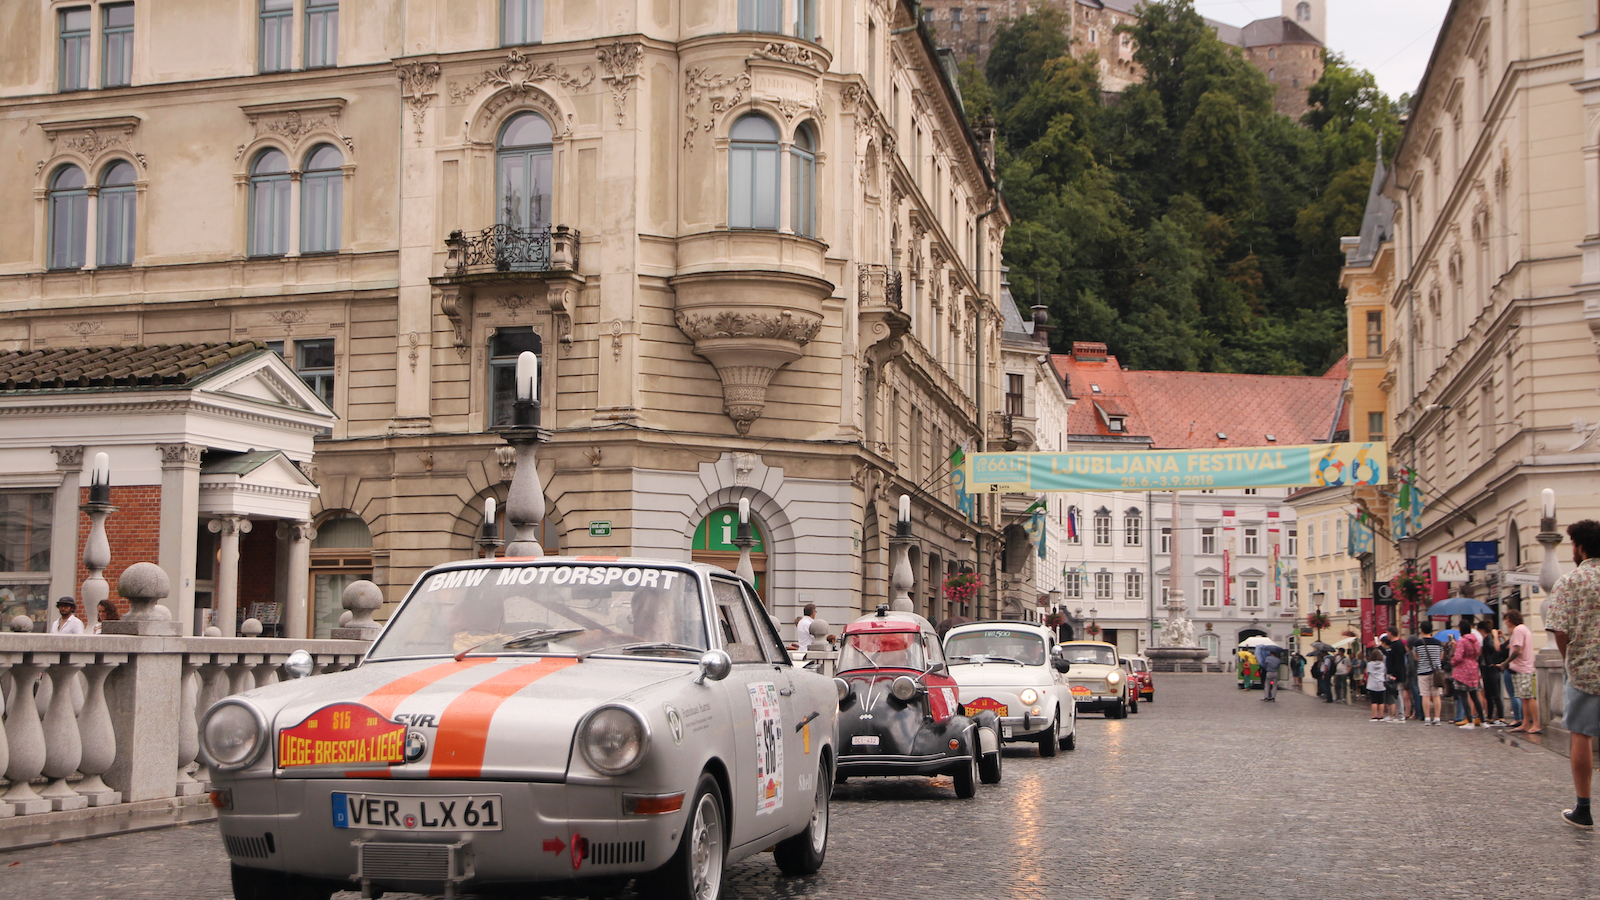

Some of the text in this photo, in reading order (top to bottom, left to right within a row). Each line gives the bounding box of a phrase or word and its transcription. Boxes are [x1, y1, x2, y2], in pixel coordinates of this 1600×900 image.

[988, 457, 1026, 472] 66.LF
[1051, 451, 1288, 474] LJUBLJANA FESTIVAL
[427, 566, 679, 592] BMW MOTORSPORT
[332, 711, 351, 730] S15
[798, 773, 813, 791] Shell
[348, 797, 499, 827] VER LX 61
